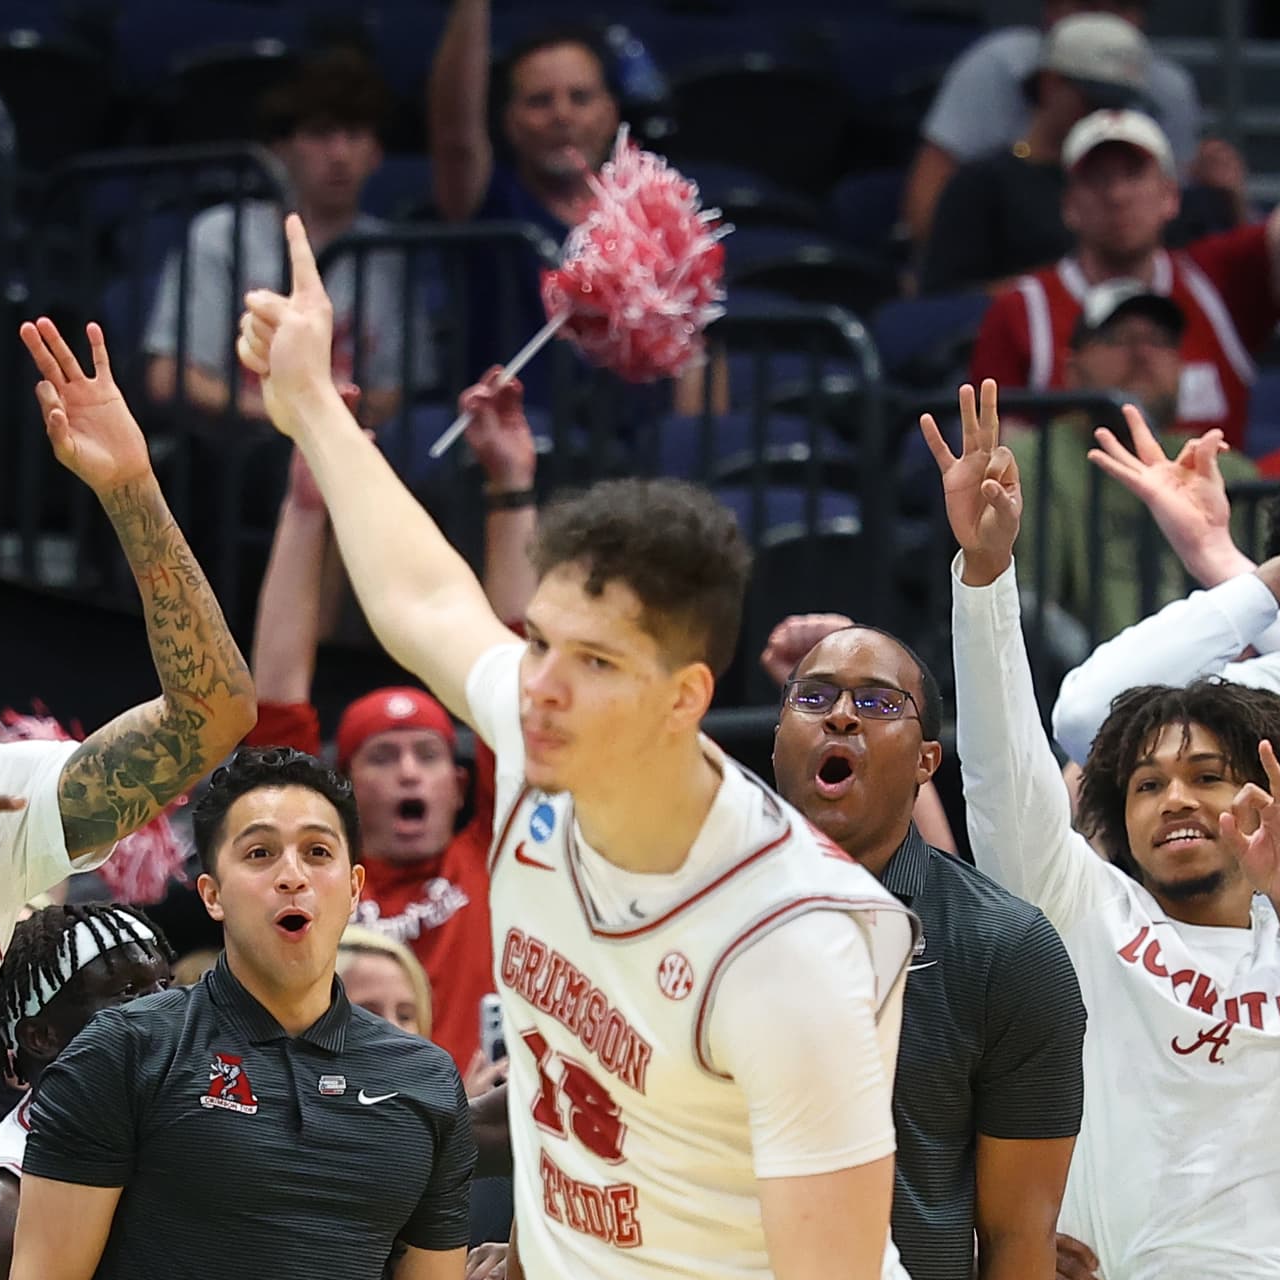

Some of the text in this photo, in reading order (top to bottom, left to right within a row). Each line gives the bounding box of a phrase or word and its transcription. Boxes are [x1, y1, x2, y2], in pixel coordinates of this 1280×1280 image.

[501, 926, 654, 1096] CRIMSON
[659, 952, 694, 1000] SEC
[539, 1145, 643, 1249] TIDE
